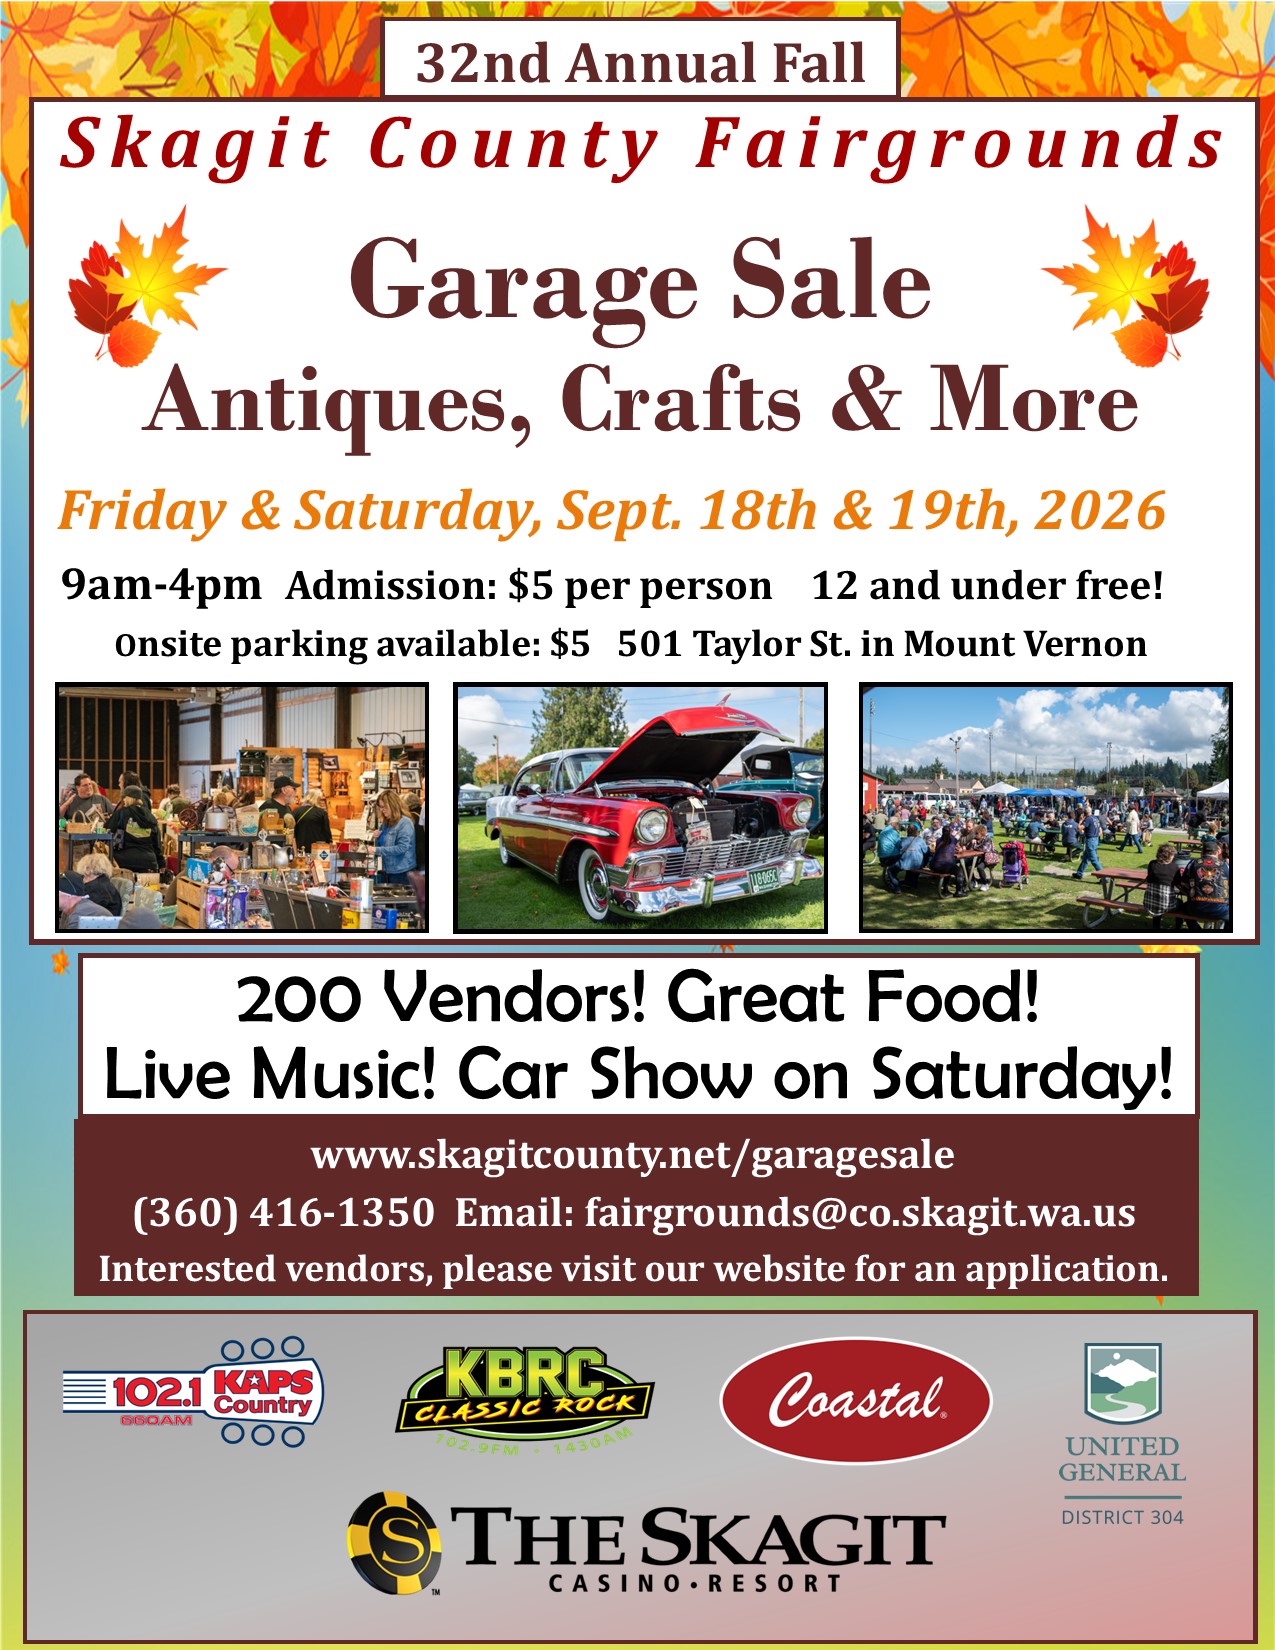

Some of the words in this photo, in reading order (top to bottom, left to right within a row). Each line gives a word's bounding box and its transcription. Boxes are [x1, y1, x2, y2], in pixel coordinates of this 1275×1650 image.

[417, 41, 550, 83] 32nd
[565, 41, 756, 83] Annual
[773, 41, 865, 83] Fall
[60, 114, 330, 184] Skagit
[370, 116, 658, 184] County
[695, 114, 1222, 184] Fairgrounds
[351, 237, 697, 349] Garage
[733, 236, 930, 319] Sale
[142, 363, 530, 456] Antiques,
[562, 363, 801, 432] Crafts
[832, 364, 902, 431] &
[930, 363, 1139, 432] More
[57, 488, 227, 542] Friday
[242, 490, 280, 530] &
[294, 488, 541, 542] Saturday,
[557, 490, 680, 542] Sept.
[700, 488, 816, 530] 18th
[834, 490, 872, 530] &
[889, 488, 1018, 537] 19th,
[1034, 490, 1166, 530] 2026
[62, 568, 262, 609] 9am-4pm
[285, 569, 495, 600] Admission:
[509, 567, 553, 603] $5
[565, 578, 630, 608] per
[640, 578, 772, 608] person
[813, 570, 857, 599] 12
[870, 569, 940, 600] and
[951, 569, 1066, 600] under
[1076, 569, 1162, 600] free!
[116, 630, 221, 657] Onsite
[231, 629, 368, 665] parking
[377, 629, 539, 657] available:
[551, 627, 589, 659] $5
[619, 629, 681, 657] 501
[693, 629, 802, 665] Taylor
[810, 630, 850, 657] St.
[861, 630, 894, 656] in
[904, 630, 1015, 657] Mount
[1023, 630, 1147, 657] Vernon
[237, 976, 361, 1022] 200
[384, 969, 644, 1022] Vendors!
[668, 968, 845, 1023] Great
[868, 969, 1037, 1022] Food!
[107, 1047, 230, 1099] Live
[254, 1046, 434, 1099] Music!
[459, 1045, 568, 1100] Car
[591, 1046, 752, 1099] Show
[774, 1062, 847, 1099] on
[873, 1046, 1171, 1109] Saturday!
[310, 1138, 954, 1178] www.skagitcounty.net/garagesale
[134, 1196, 237, 1235] (360)
[250, 1196, 434, 1227] 416-1350
[456, 1196, 572, 1227] Email:
[585, 1196, 1135, 1236] fairgrounds@co.skagit.wa.us
[100, 1254, 276, 1282] Interested
[285, 1254, 432, 1286] vendors,
[443, 1254, 552, 1289] please
[561, 1255, 636, 1282] visit
[645, 1262, 704, 1282] our
[713, 1254, 845, 1282] website
[855, 1254, 905, 1282] for
[915, 1262, 956, 1282] an
[966, 1254, 1167, 1289] application.
[113, 1377, 201, 1407] 102.1
[214, 1369, 313, 1395] KAPS
[446, 1348, 604, 1398] KBRC
[214, 1395, 313, 1417] Country
[414, 1397, 542, 1424] CLASSIC
[554, 1394, 637, 1415] ROCK
[769, 1372, 944, 1427] Coastal
[121, 1415, 193, 1426] 660AM
[434, 1432, 520, 1456] 102.9FM
[553, 1426, 634, 1455] 1430AM
[1065, 1436, 1179, 1456] UNITED
[1058, 1463, 1187, 1482] GENERAL
[1062, 1510, 1144, 1525] DISTRICT
[1150, 1510, 1185, 1525] 304
[382, 1517, 424, 1564] S
[549, 1574, 680, 1593] CASINO
[708, 1574, 841, 1593] RESORT
